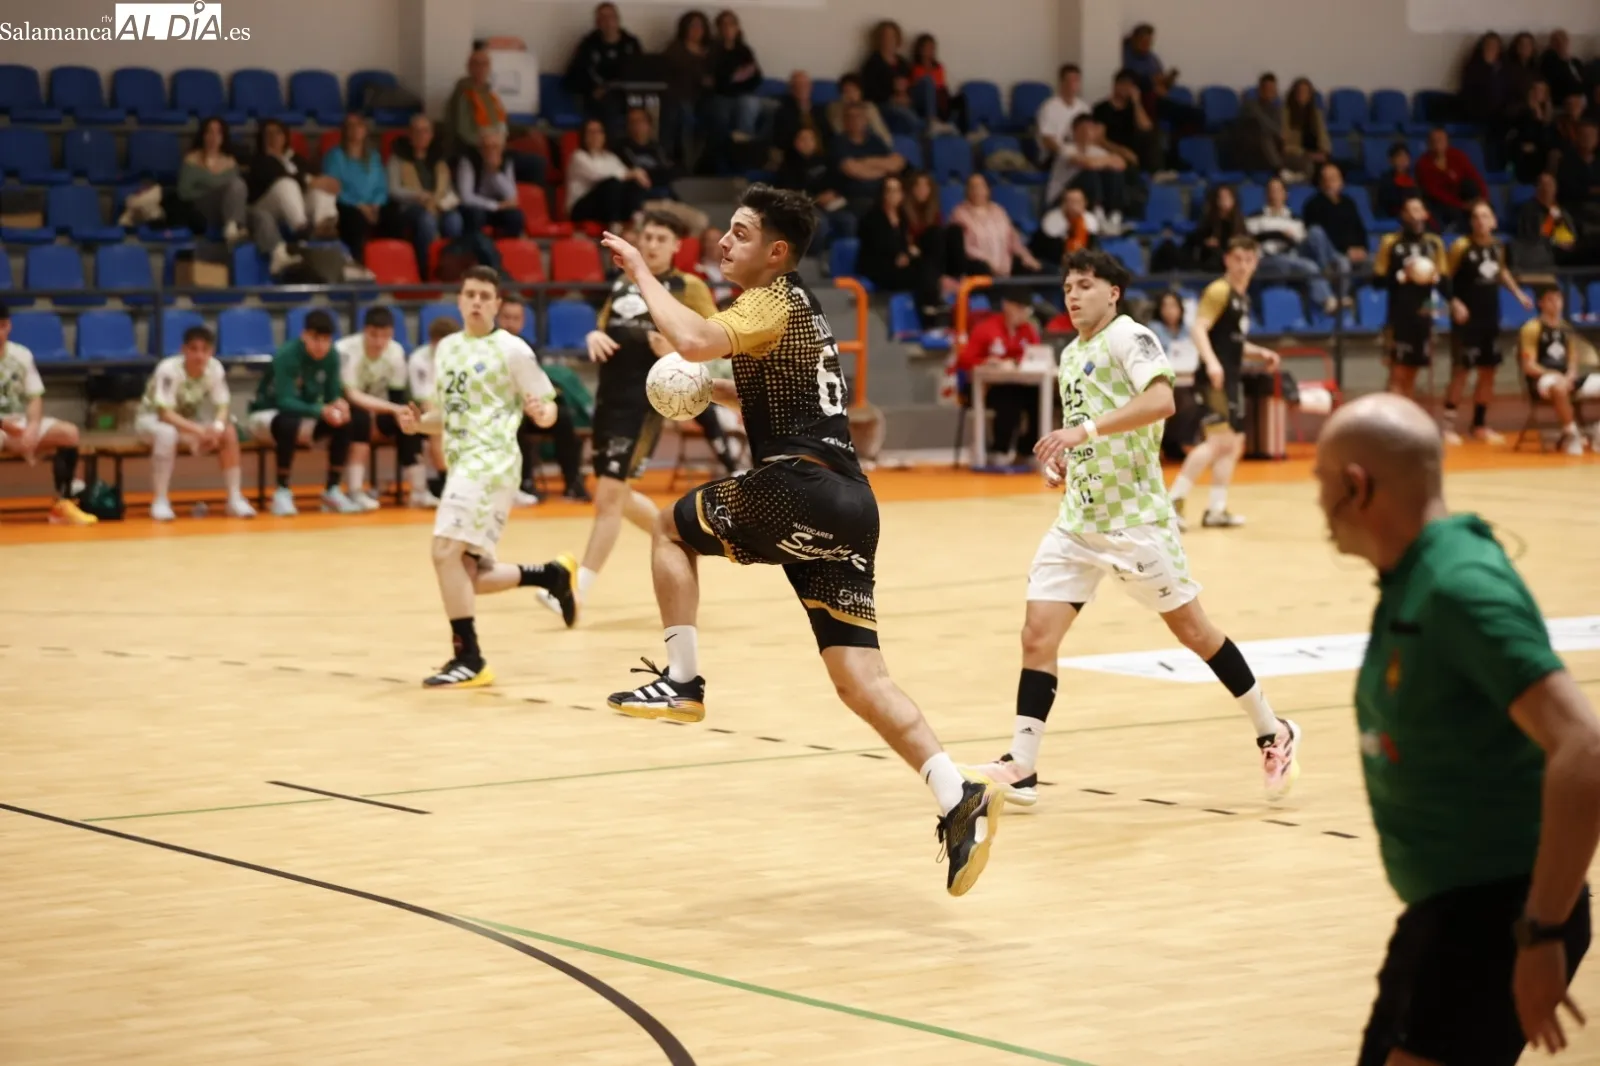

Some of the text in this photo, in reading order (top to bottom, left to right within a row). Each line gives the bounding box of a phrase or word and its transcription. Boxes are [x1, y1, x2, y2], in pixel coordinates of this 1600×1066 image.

[444, 371, 468, 394] 28
[817, 344, 847, 416] 6
[792, 522, 834, 541] AUTOCARES
